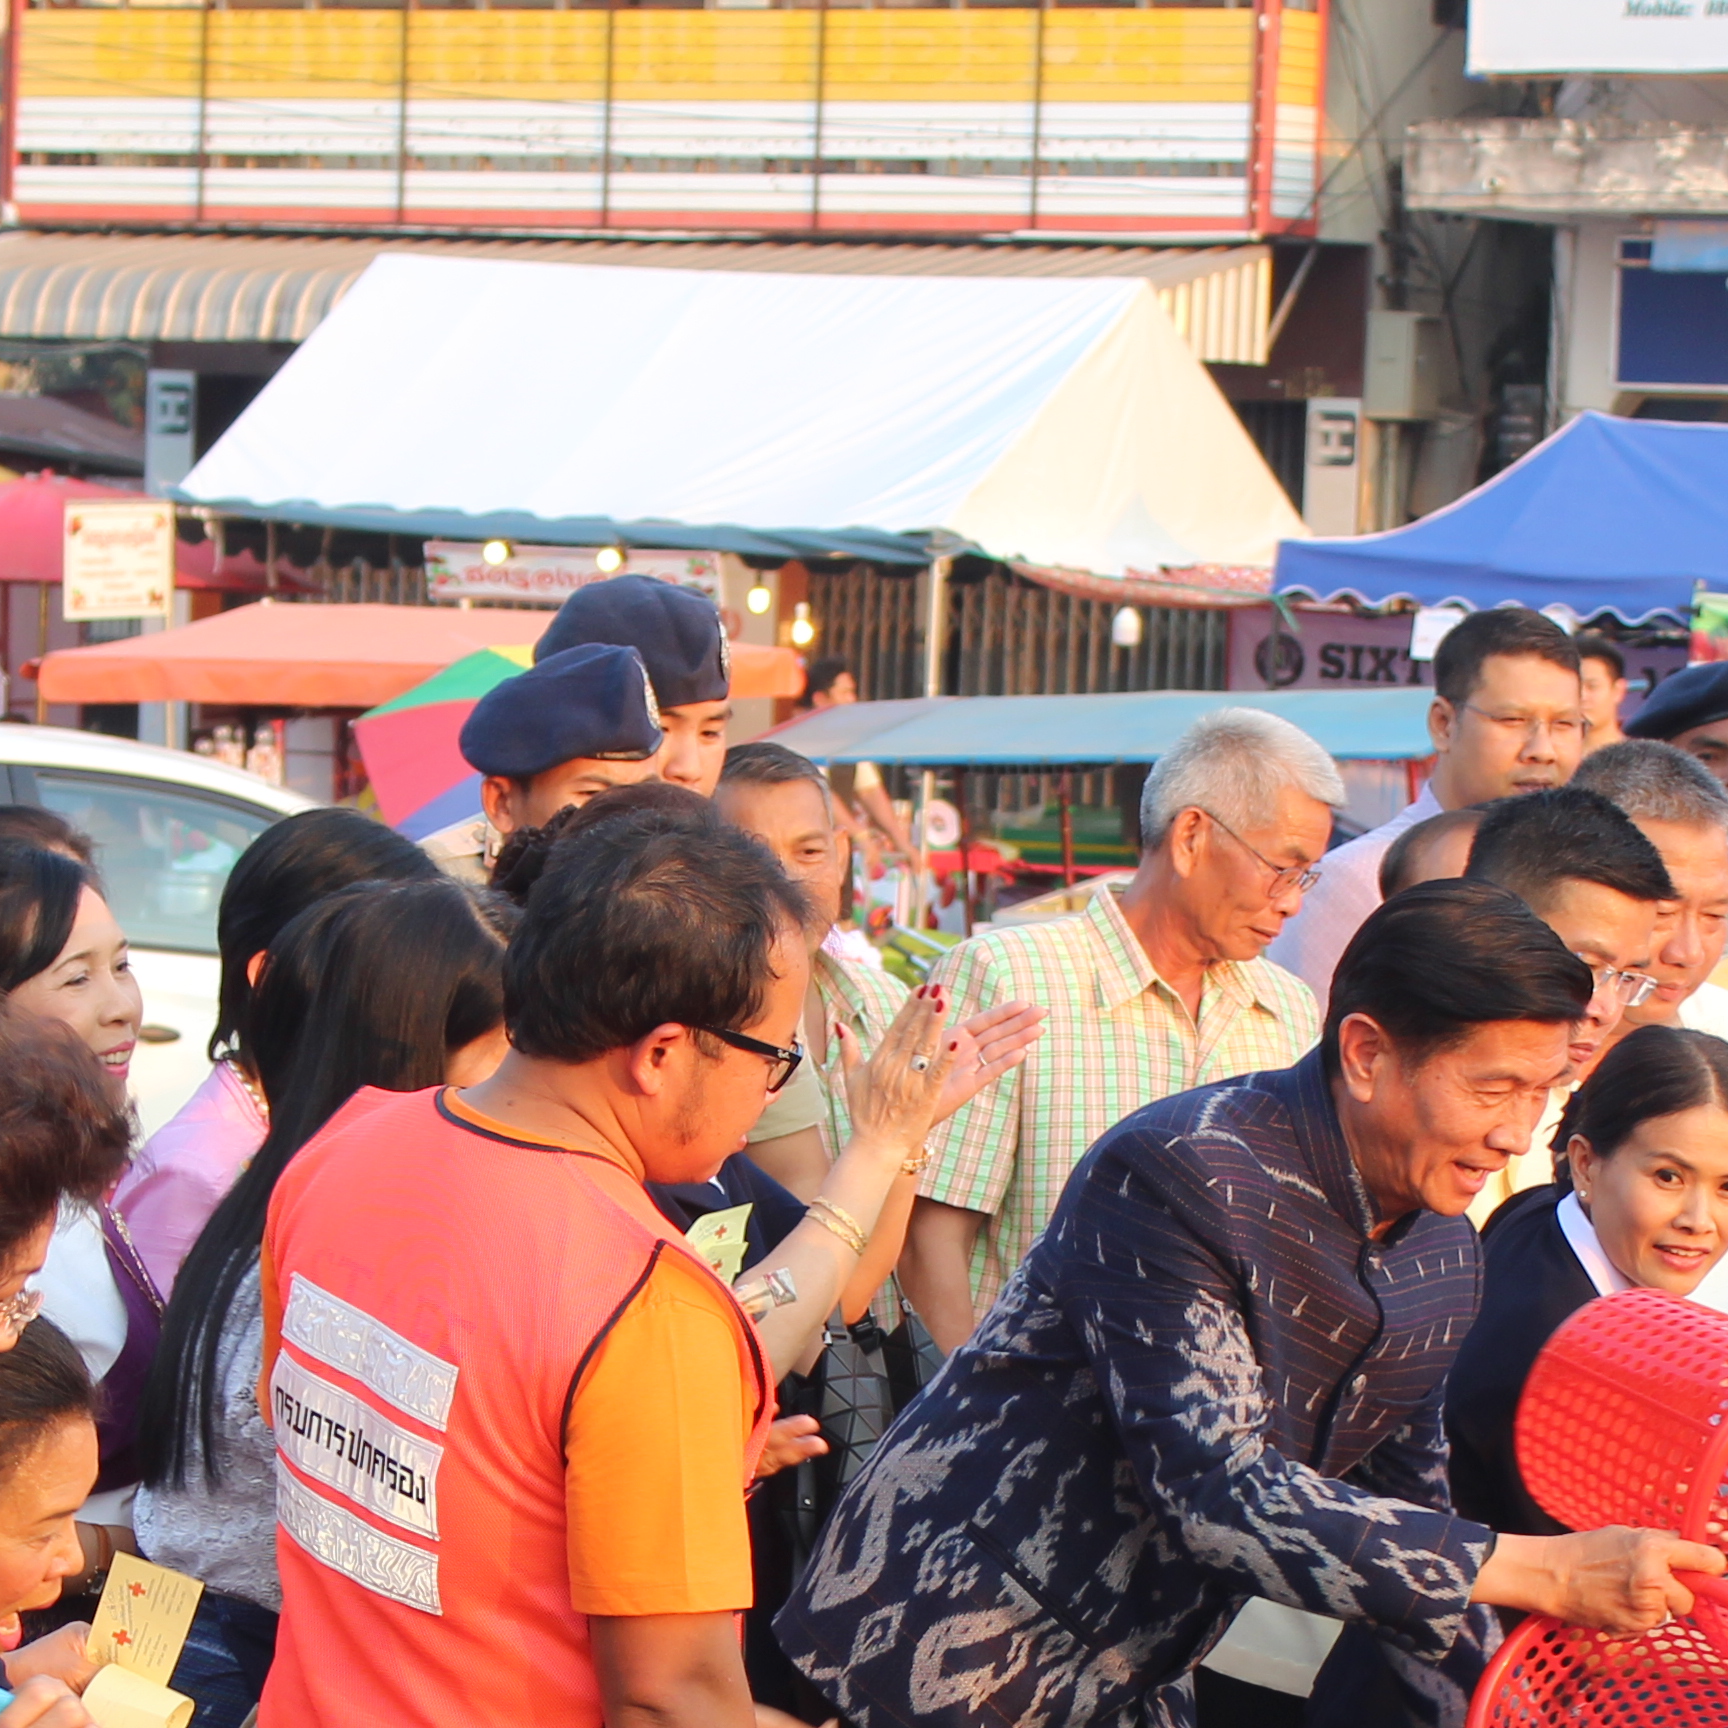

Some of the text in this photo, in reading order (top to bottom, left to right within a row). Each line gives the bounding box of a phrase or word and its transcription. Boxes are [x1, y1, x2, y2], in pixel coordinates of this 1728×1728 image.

[276, 1386, 426, 1504] กรมการปกครอง
